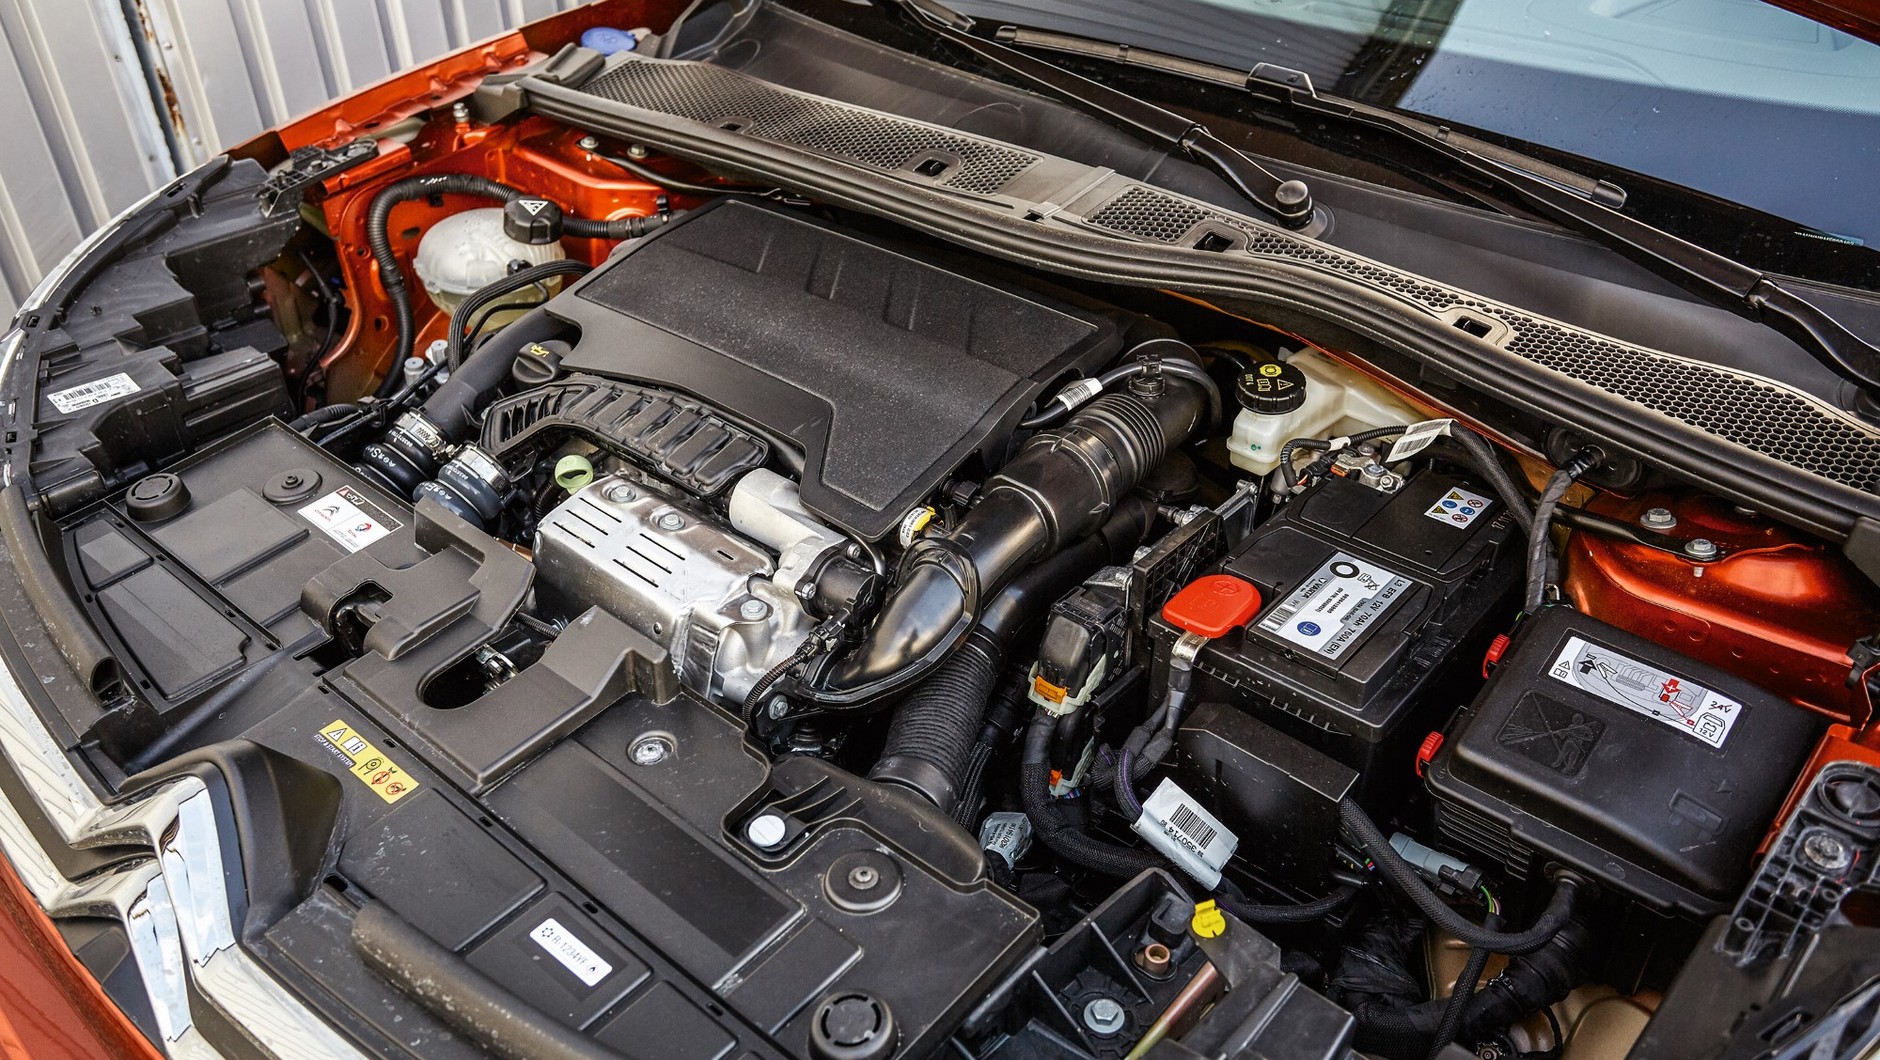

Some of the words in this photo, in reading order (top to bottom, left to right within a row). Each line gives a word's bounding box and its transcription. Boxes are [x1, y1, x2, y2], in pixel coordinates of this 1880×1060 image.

[1302, 581, 1323, 599] VARTA
[1381, 587, 1397, 599] EFB
[1369, 600, 1384, 611] 12V
[1352, 611, 1372, 626] 70Ah
[1169, 827, 1197, 852] 350714
